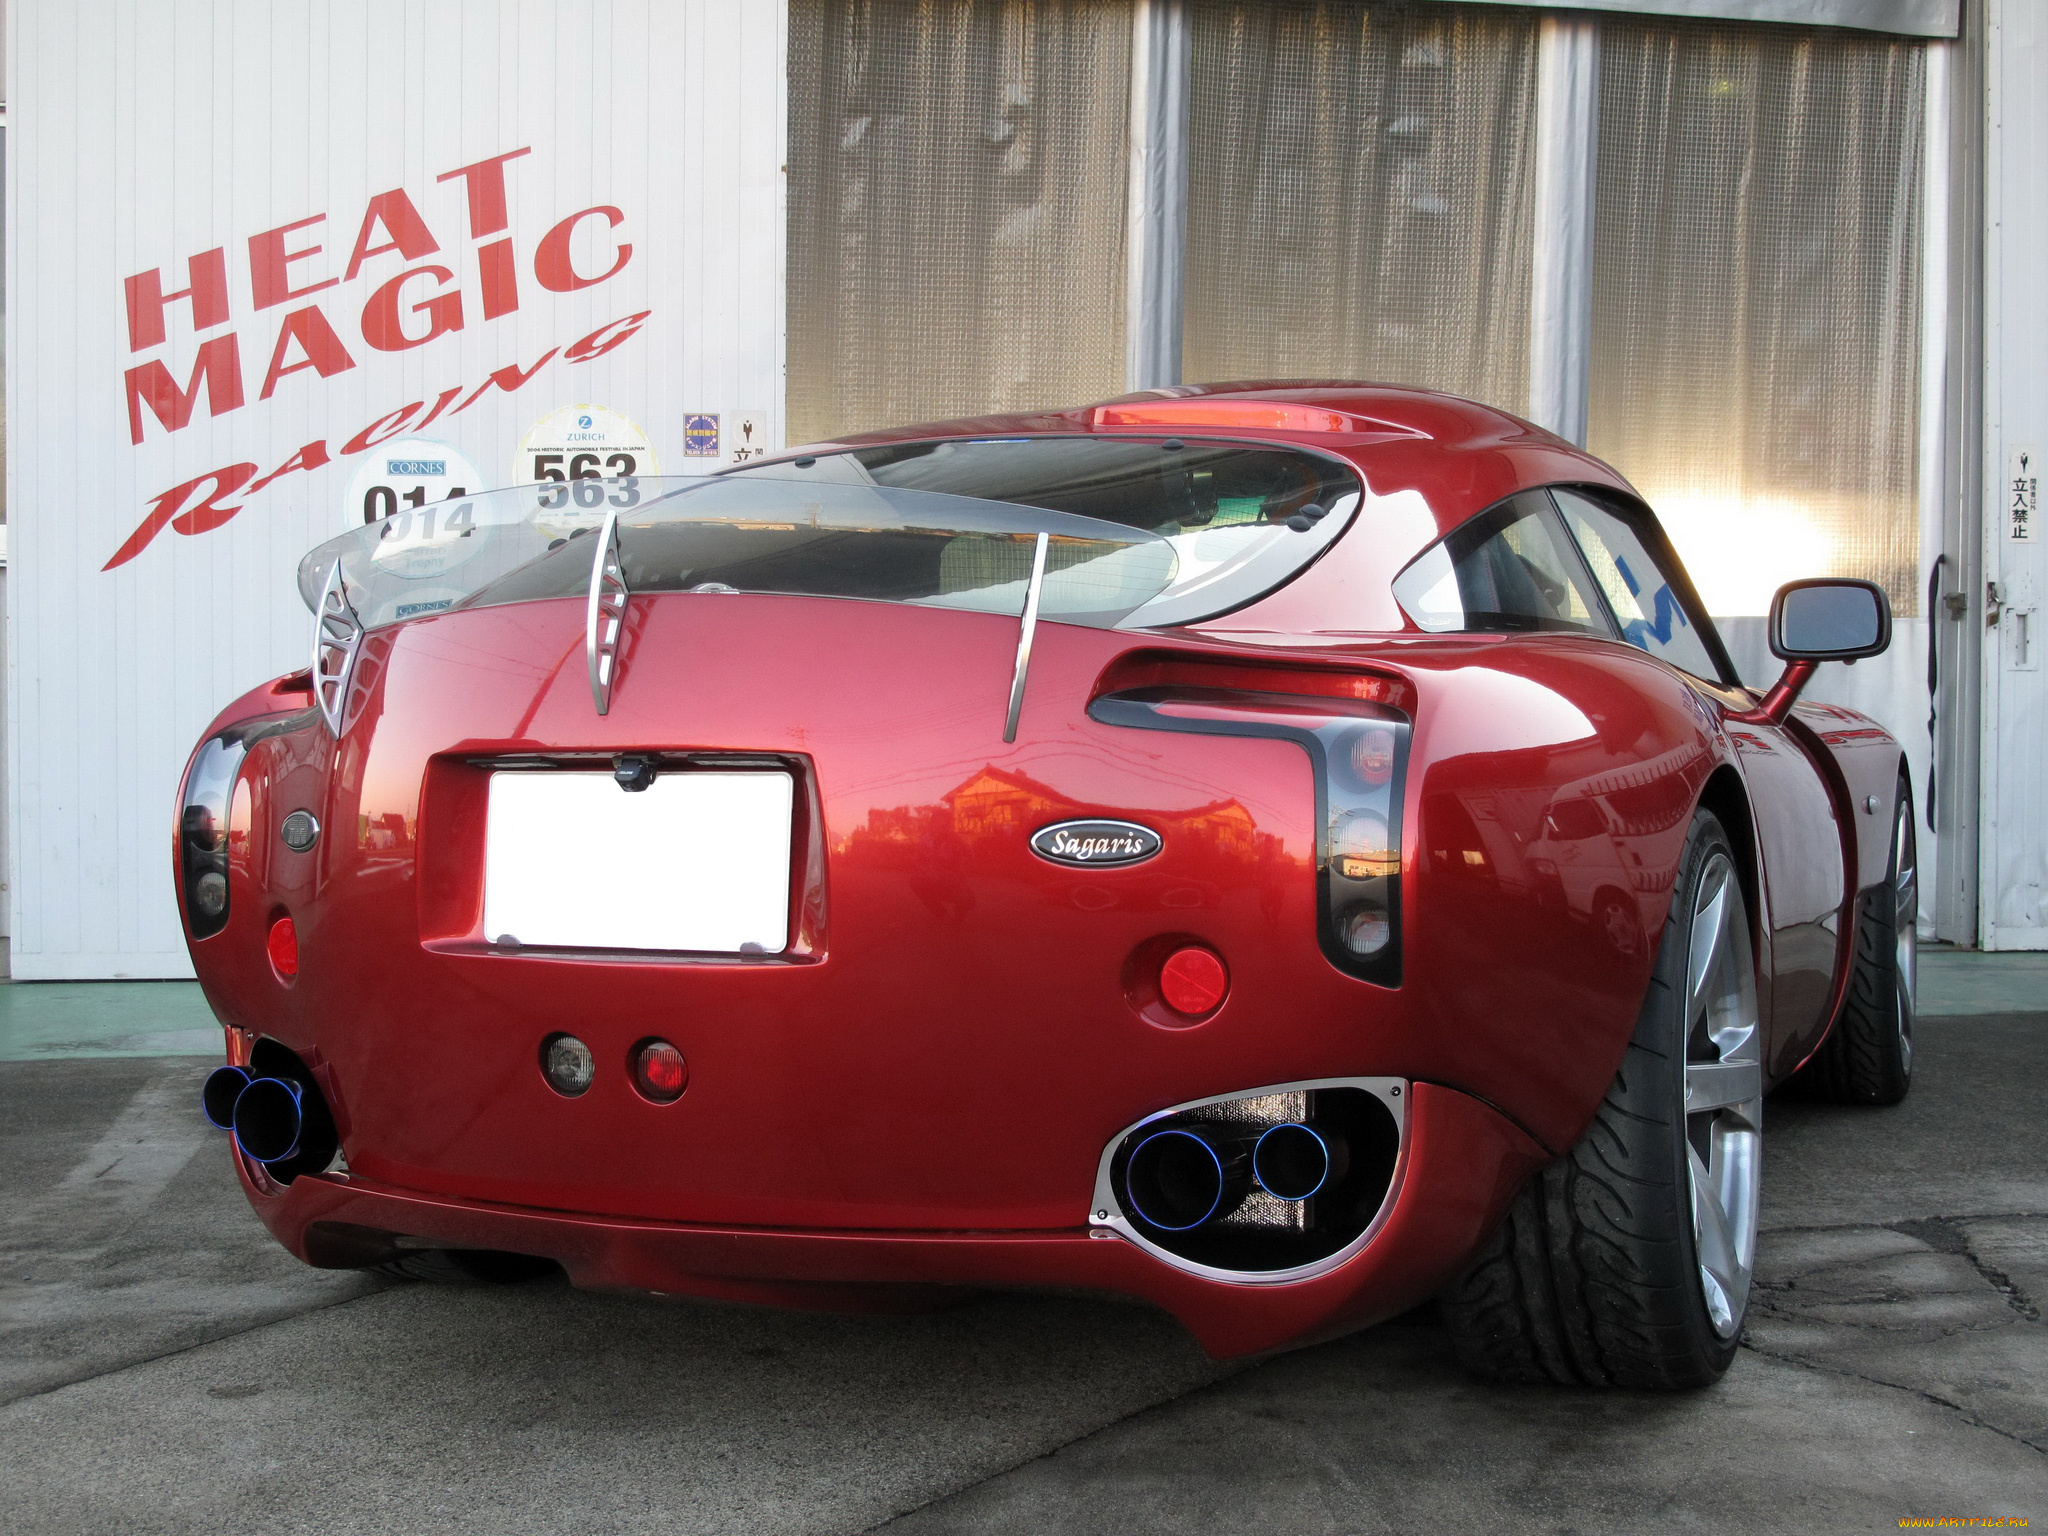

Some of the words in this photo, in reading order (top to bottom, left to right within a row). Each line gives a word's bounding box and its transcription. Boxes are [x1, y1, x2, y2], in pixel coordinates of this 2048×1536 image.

[125, 147, 531, 353] HEAT
[125, 206, 633, 445] MAGIC
[567, 433, 605, 441] ZURICH
[390, 462, 443, 474] CORNES
[2011, 478, 2028, 539] 立入禁止
[1051, 830, 1144, 860] Sagaris
